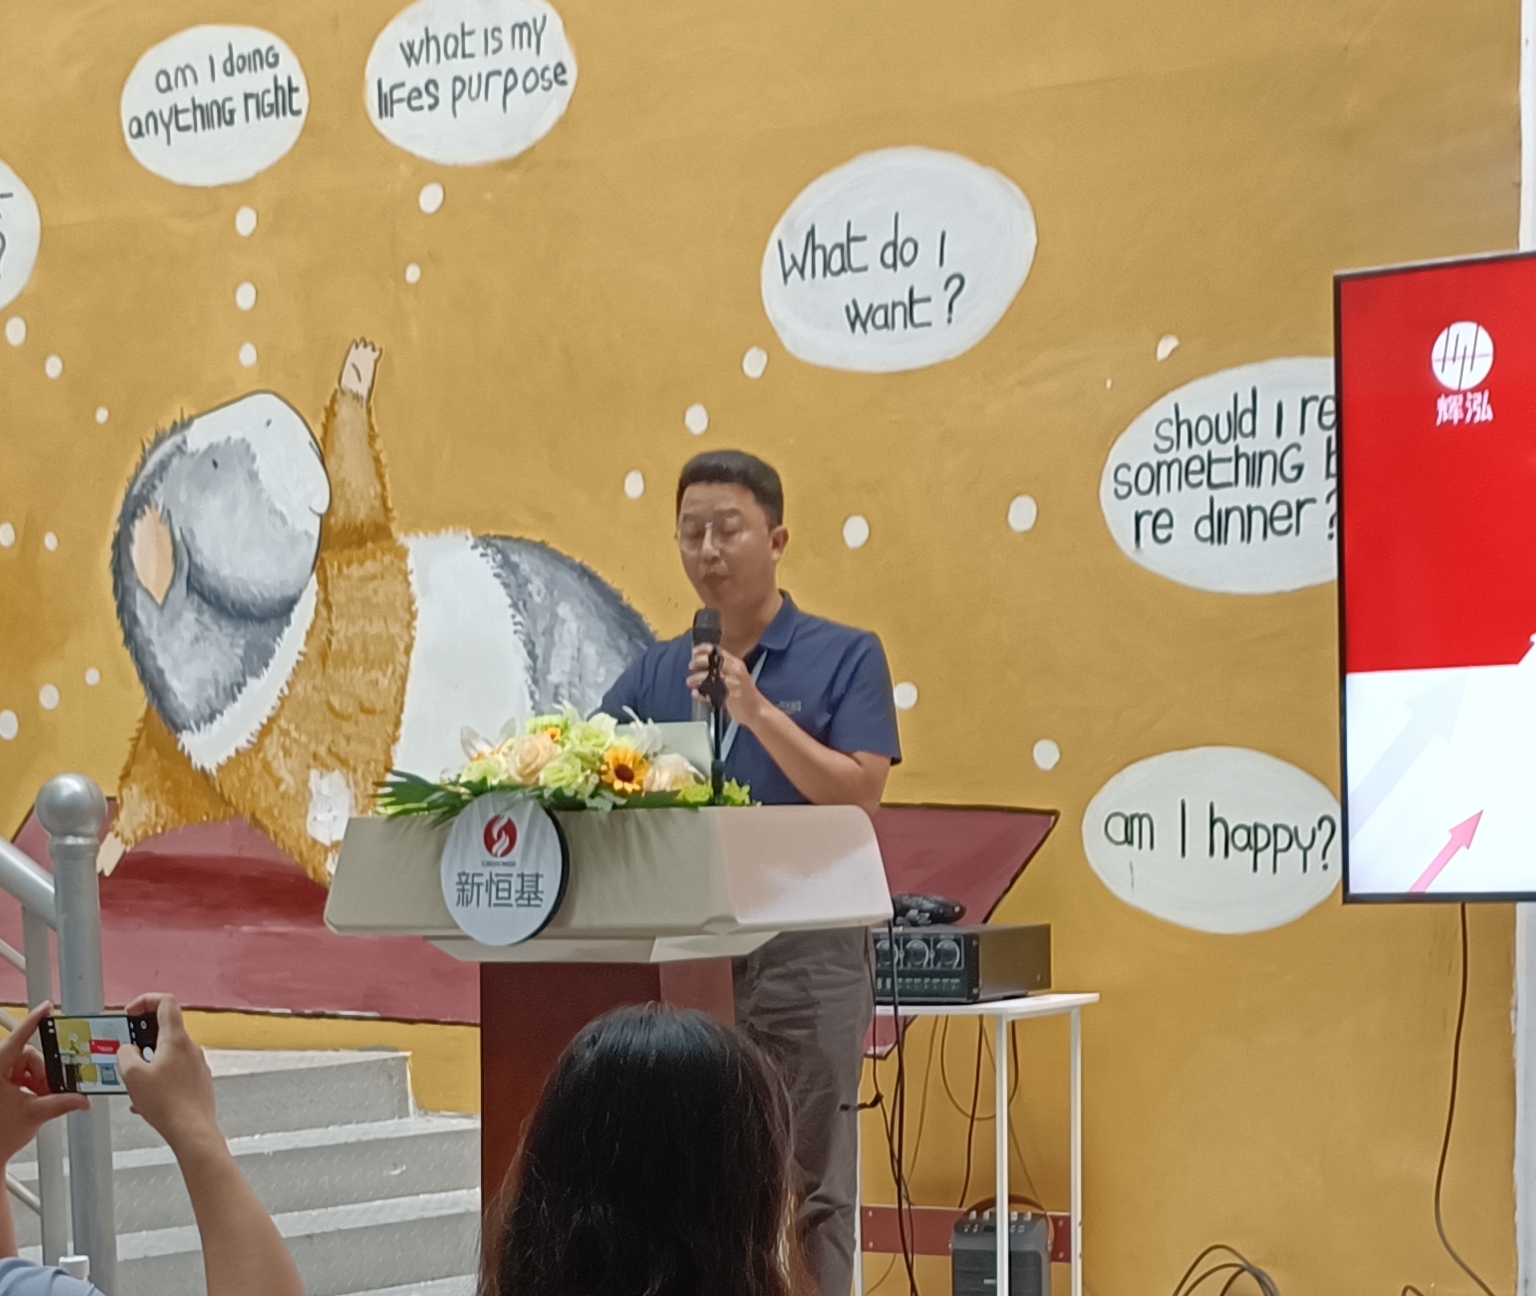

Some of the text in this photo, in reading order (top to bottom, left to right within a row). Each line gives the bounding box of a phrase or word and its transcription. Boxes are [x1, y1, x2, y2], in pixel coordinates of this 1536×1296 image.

[155, 63, 199, 94] am
[222, 41, 280, 77] doing
[399, 13, 547, 68] what is my
[129, 74, 302, 147] anything right
[377, 61, 569, 119] lifes purpose
[777, 219, 869, 287] What
[879, 211, 919, 273] do
[1153, 385, 1257, 454] should
[1435, 388, 1494, 428] 辉泓
[1114, 442, 1305, 501] something
[1134, 507, 1174, 550] re
[1104, 811, 1154, 851] am
[1208, 800, 1337, 875] happy?
[455, 870, 545, 909] 新恒基
